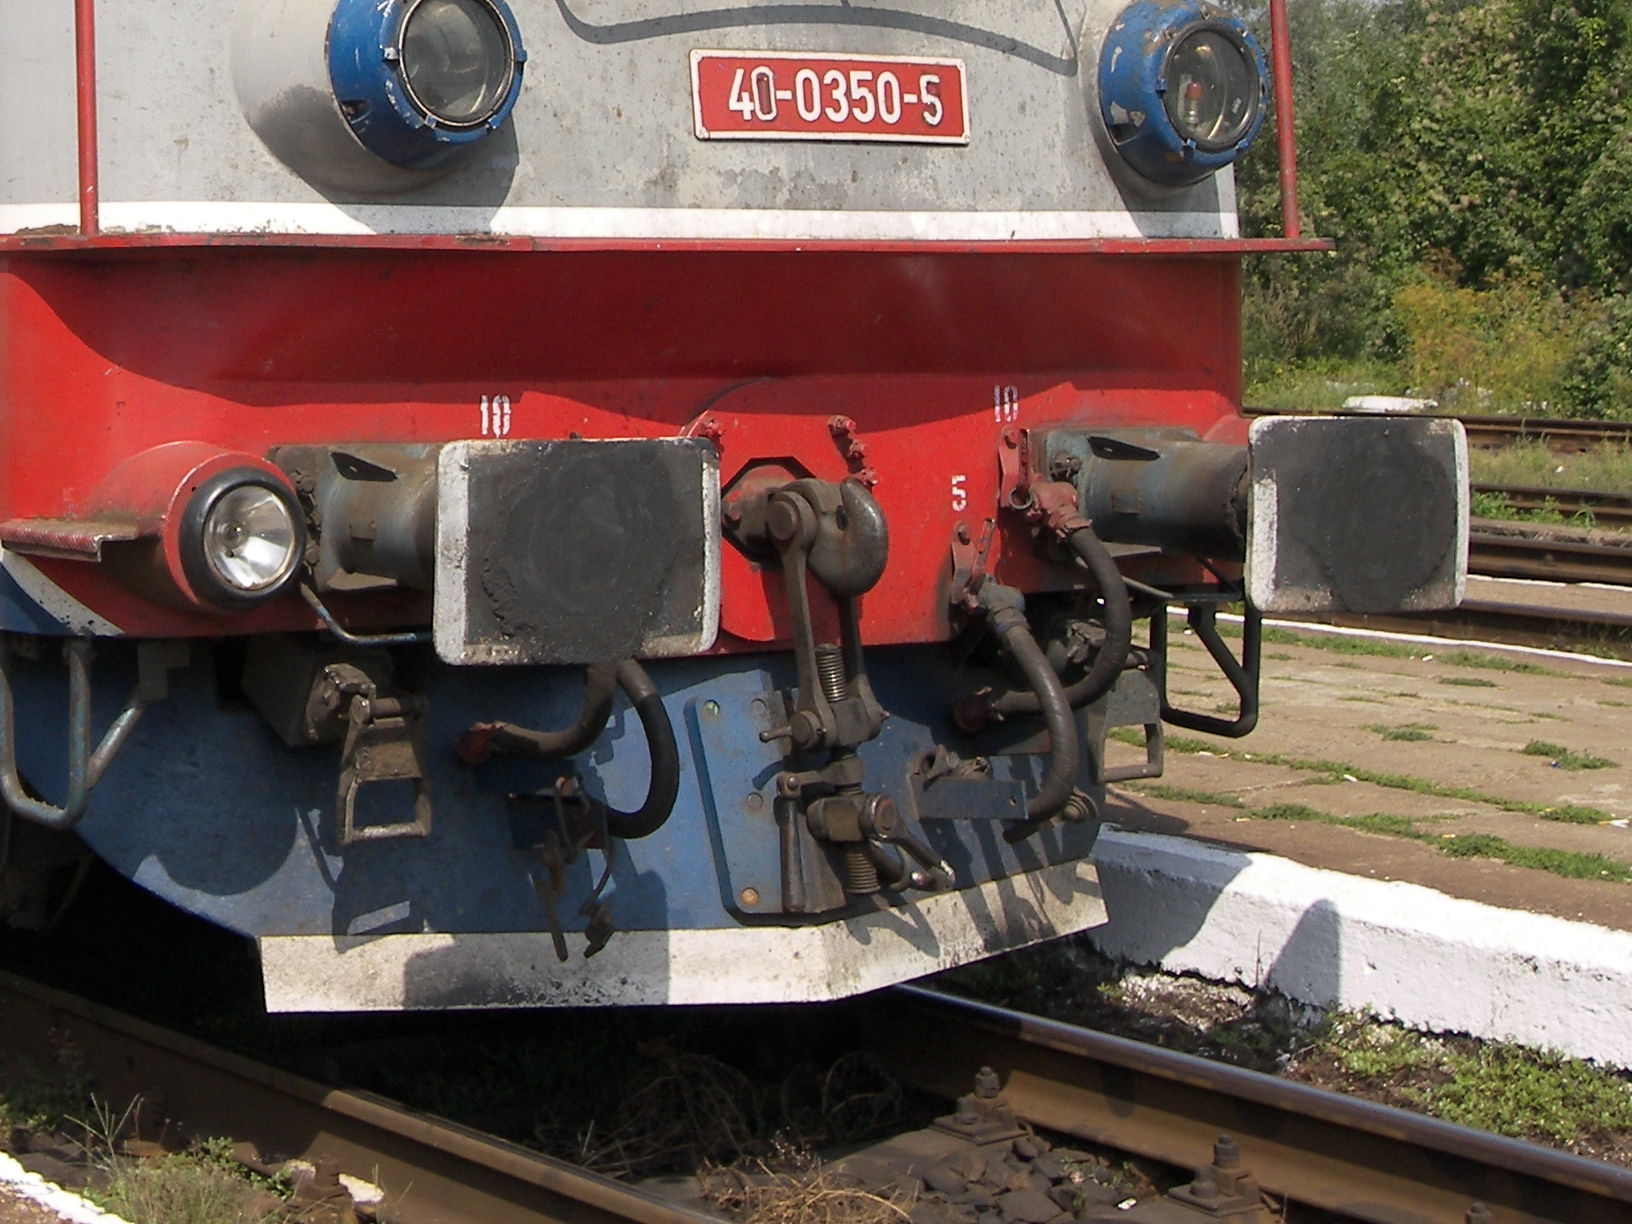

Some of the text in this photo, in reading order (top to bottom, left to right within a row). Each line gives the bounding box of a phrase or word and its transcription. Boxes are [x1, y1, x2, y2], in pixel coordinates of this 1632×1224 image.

[728, 65, 944, 127] 40-0350-5
[480, 394, 511, 438] 10
[994, 384, 1019, 423] 10
[951, 474, 966, 512] 5
